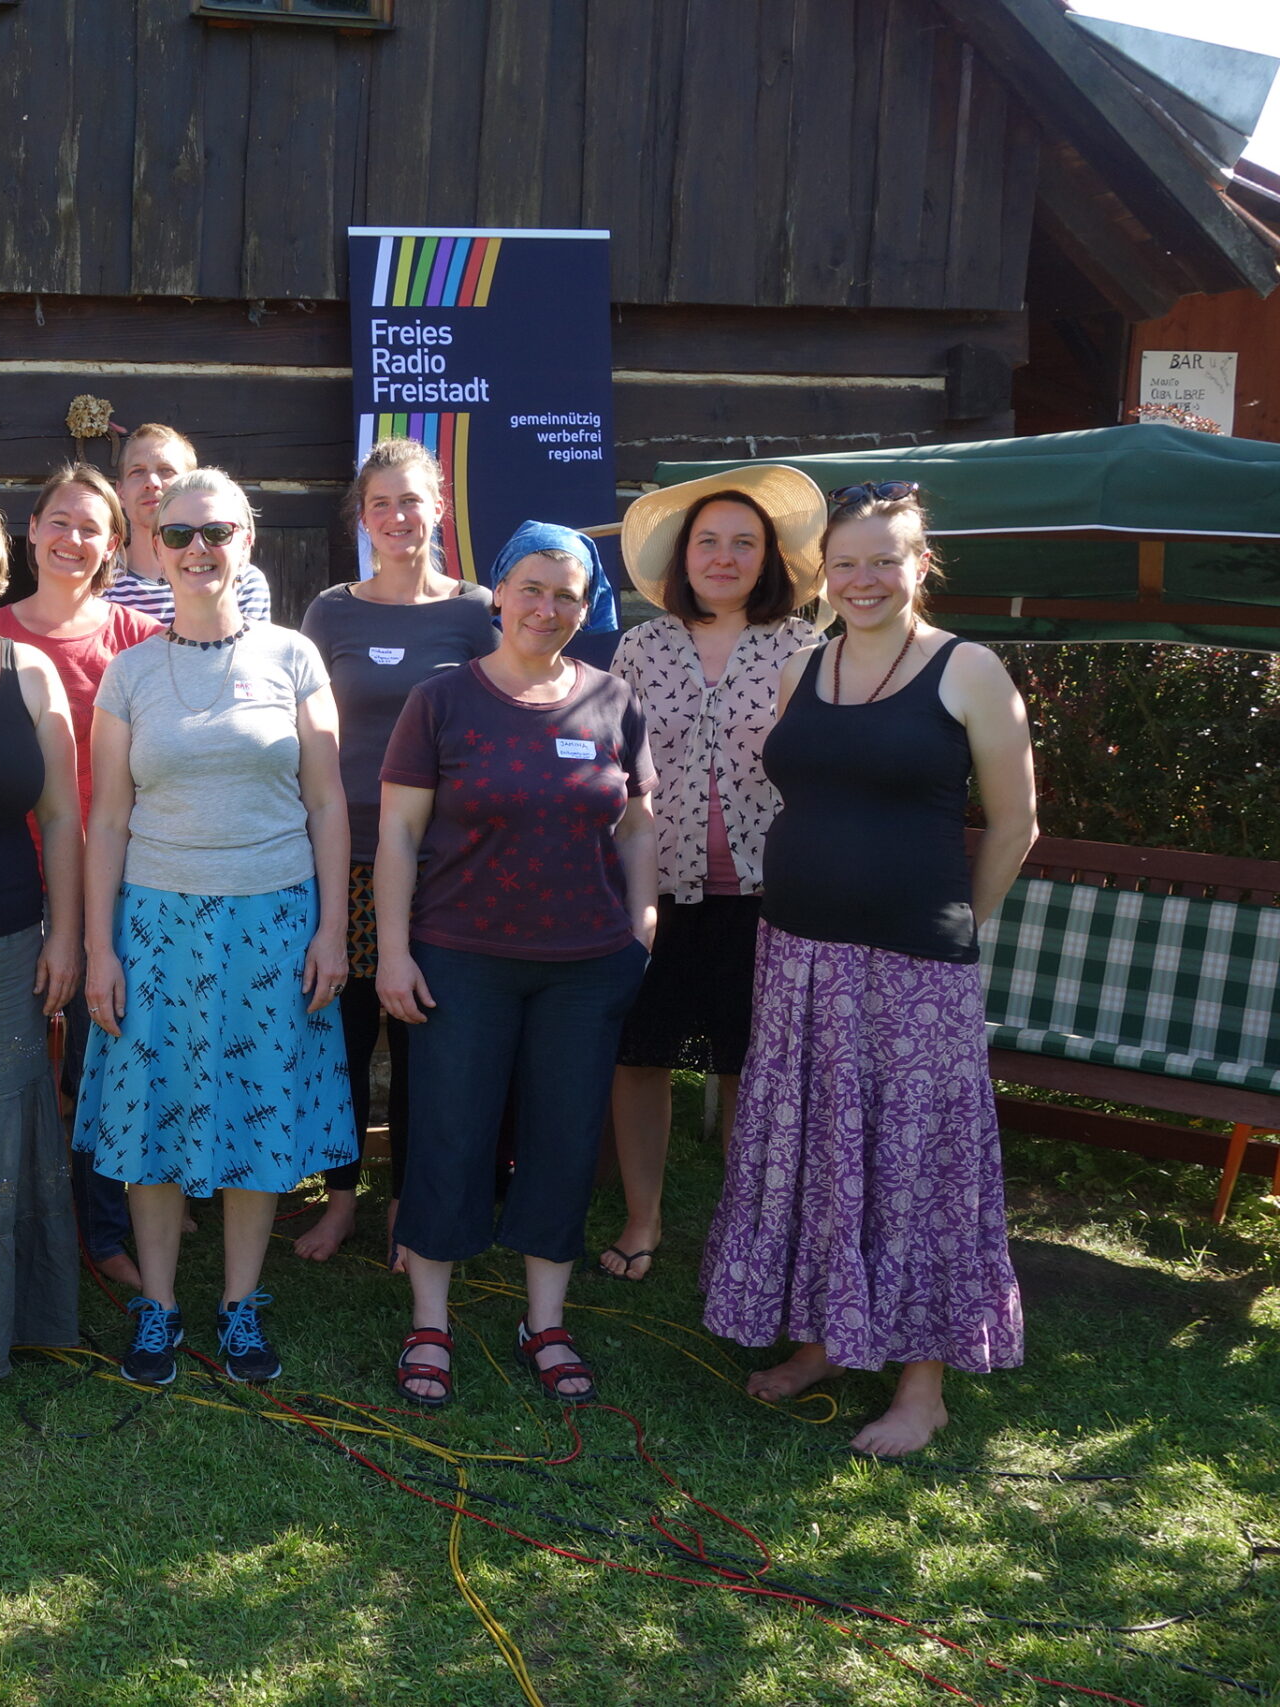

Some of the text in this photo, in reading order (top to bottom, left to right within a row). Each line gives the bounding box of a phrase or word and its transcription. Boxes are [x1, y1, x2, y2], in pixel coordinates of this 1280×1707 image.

[371, 319, 453, 345] Freies
[372, 347, 446, 374] Radio
[1169, 354, 1205, 369] BAR
[373, 376, 490, 403] Freistadt
[510, 412, 601, 428] gemeinnützig
[537, 429, 602, 443] werbefrei
[548, 447, 603, 462] regional
